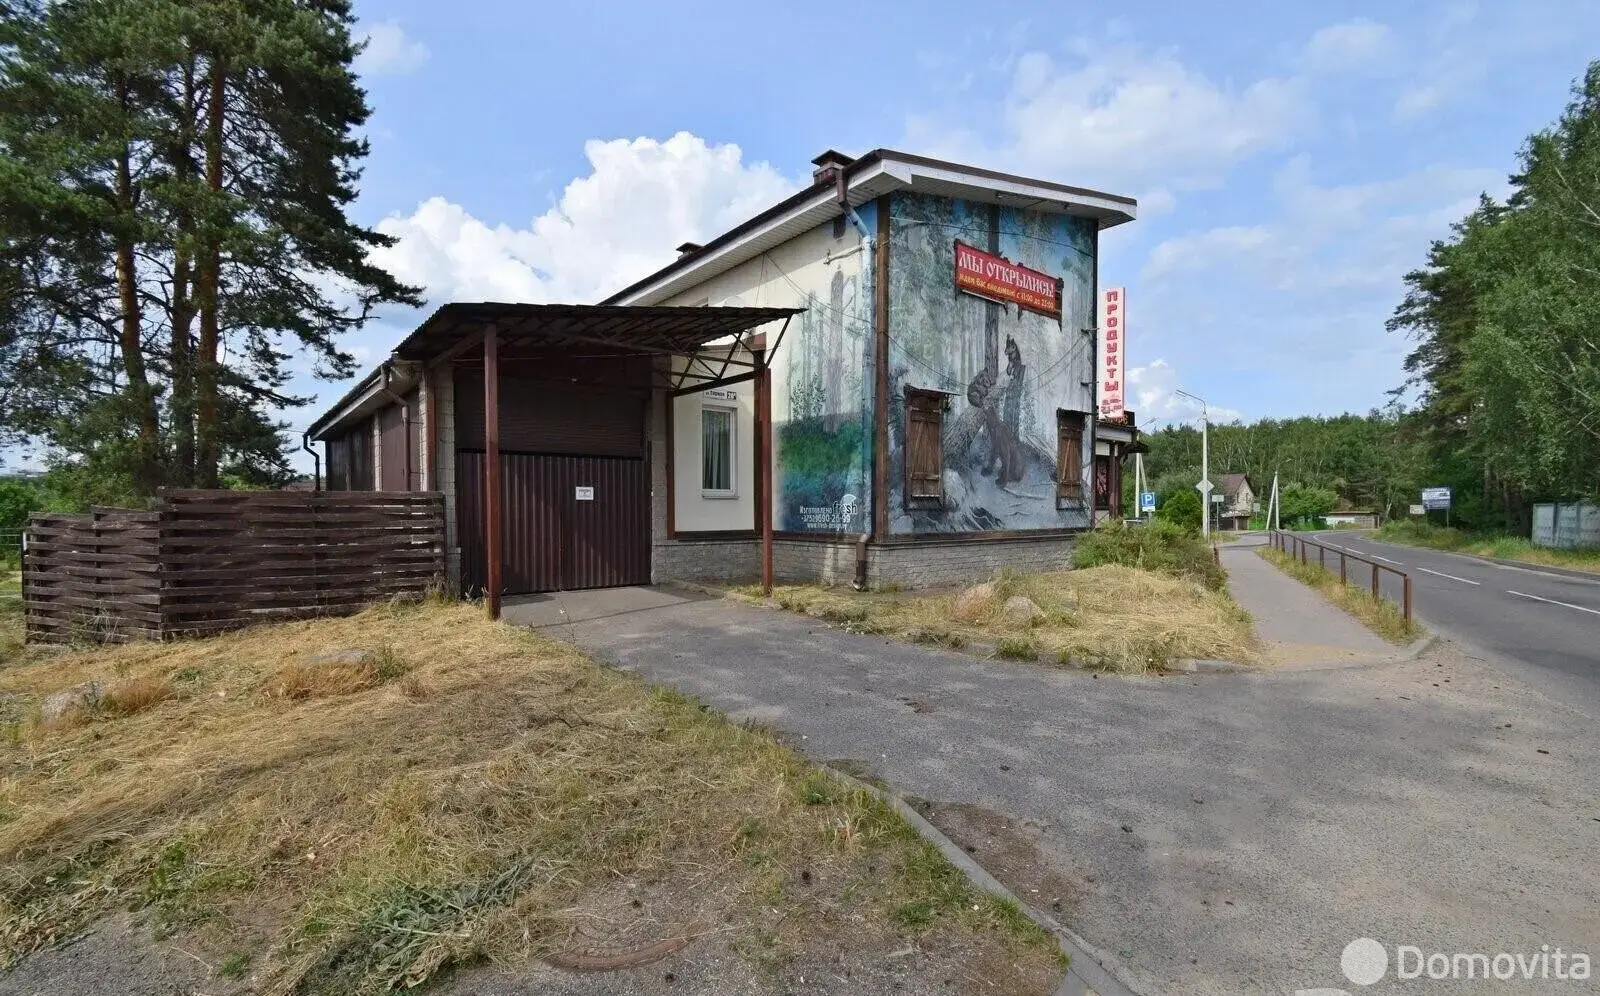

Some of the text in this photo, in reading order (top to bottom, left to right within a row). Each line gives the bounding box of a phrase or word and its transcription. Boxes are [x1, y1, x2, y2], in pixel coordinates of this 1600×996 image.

[959, 251, 1055, 299] МЫ ОТКРЫЛИСЬ!
[1105, 291, 1119, 392] ПРОДУКТЫ
[833, 501, 857, 515] fresh
[1145, 494, 1152, 503] P
